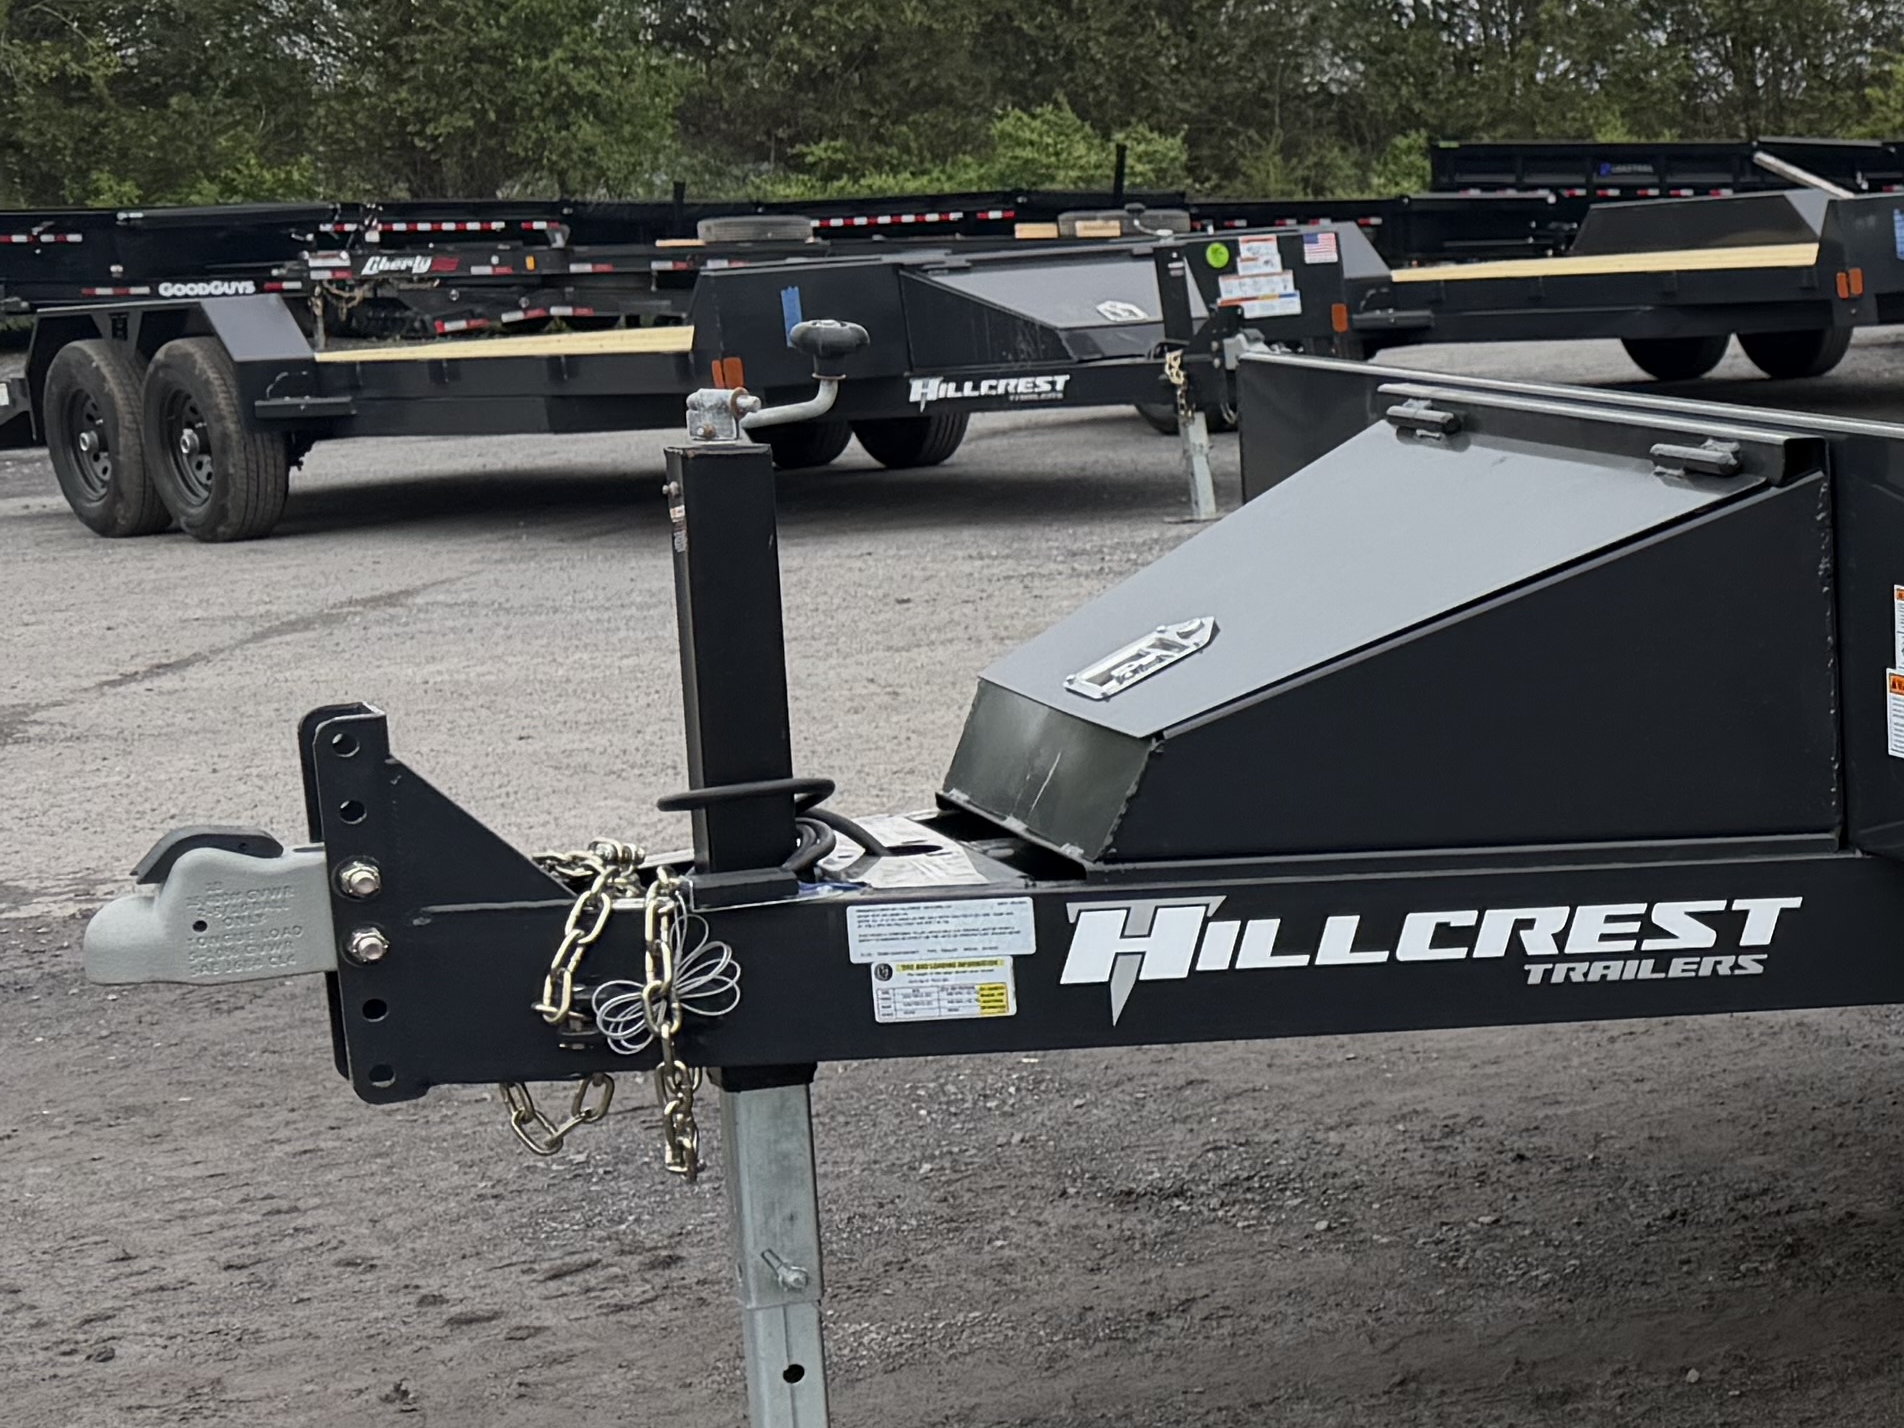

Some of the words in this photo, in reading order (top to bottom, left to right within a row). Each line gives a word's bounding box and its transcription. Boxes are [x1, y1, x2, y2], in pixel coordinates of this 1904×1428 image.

[909, 374, 1070, 403] HILLCREST
[1060, 895, 1802, 985] HILLCREST
[1524, 954, 1768, 985] TRAILERS
